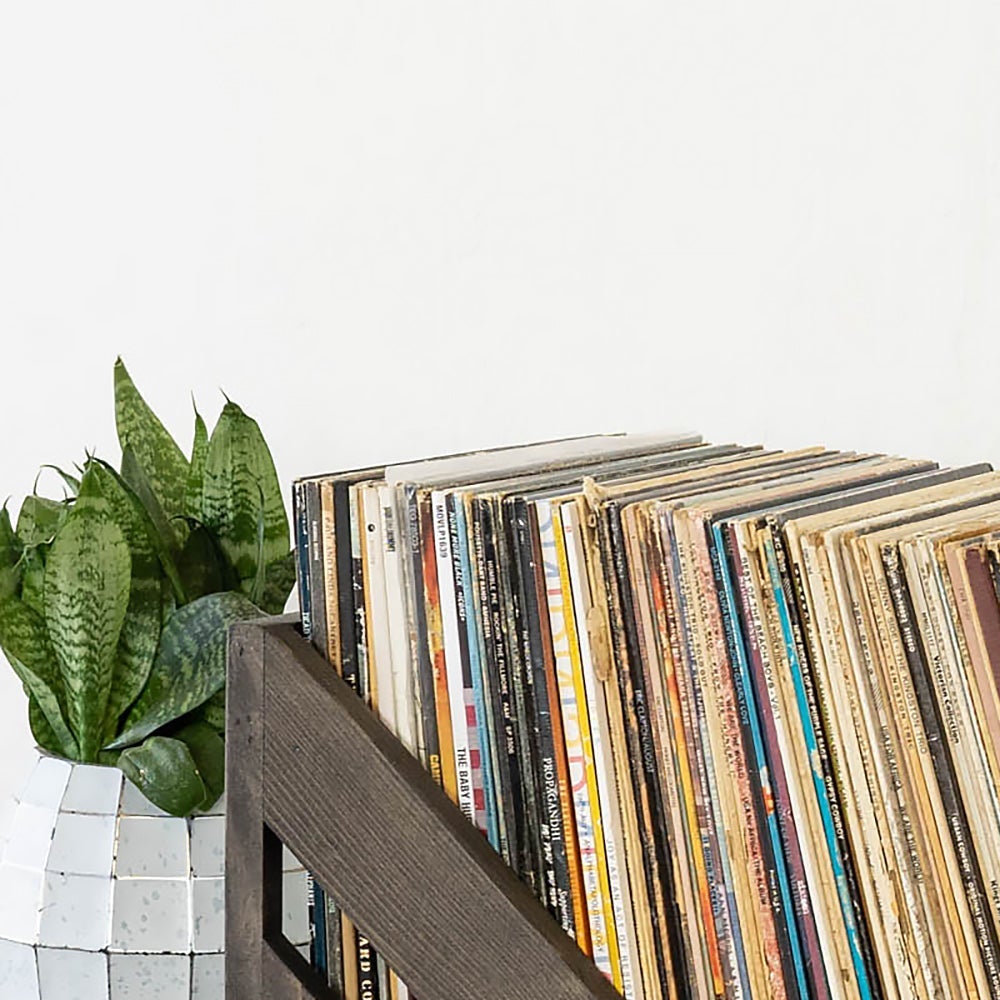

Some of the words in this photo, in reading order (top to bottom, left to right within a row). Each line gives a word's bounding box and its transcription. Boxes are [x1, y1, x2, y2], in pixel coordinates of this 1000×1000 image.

[436, 504, 448, 559] MOVLP1639
[487, 560, 497, 590] HUMBLE
[718, 590, 728, 615] OLIVIA
[747, 587, 755, 602] OF
[751, 605, 759, 621] THE
[724, 616, 739, 668] NEWTON-JOHN
[753, 623, 768, 659] BEACH
[793, 624, 802, 644] NEW
[496, 643, 504, 657] THE
[689, 613, 698, 636] TRIO
[699, 669, 708, 688] OUT
[795, 645, 809, 674] RIDERS
[498, 659, 508, 695] FILLMORE
[763, 662, 774, 689] BOYS
[878, 577, 892, 613] SUNNY
[896, 653, 906, 672] THE
[902, 676, 919, 729] KINGSTON
[915, 731, 928, 756] TRIO
[734, 672, 745, 704] CLEARLY
[800, 676, 809, 688] OF
[804, 689, 814, 705] THE
[933, 655, 949, 698] Victorian
[944, 699, 959, 744] Collection
[739, 706, 748, 725] LOVE
[809, 706, 822, 737] PURPLE
[457, 748, 468, 767] THE
[816, 738, 827, 761] SAGE
[459, 770, 470, 798] BABY
[825, 775, 837, 804] GYPSY
[542, 757, 561, 842] PROPAGANDHI
[831, 804, 845, 841] COWBOY
[957, 843, 970, 873] COWBOY
[967, 882, 982, 916] ORIGINAL
[975, 917, 989, 947] MOTION
[985, 947, 997, 974] PICTURE
